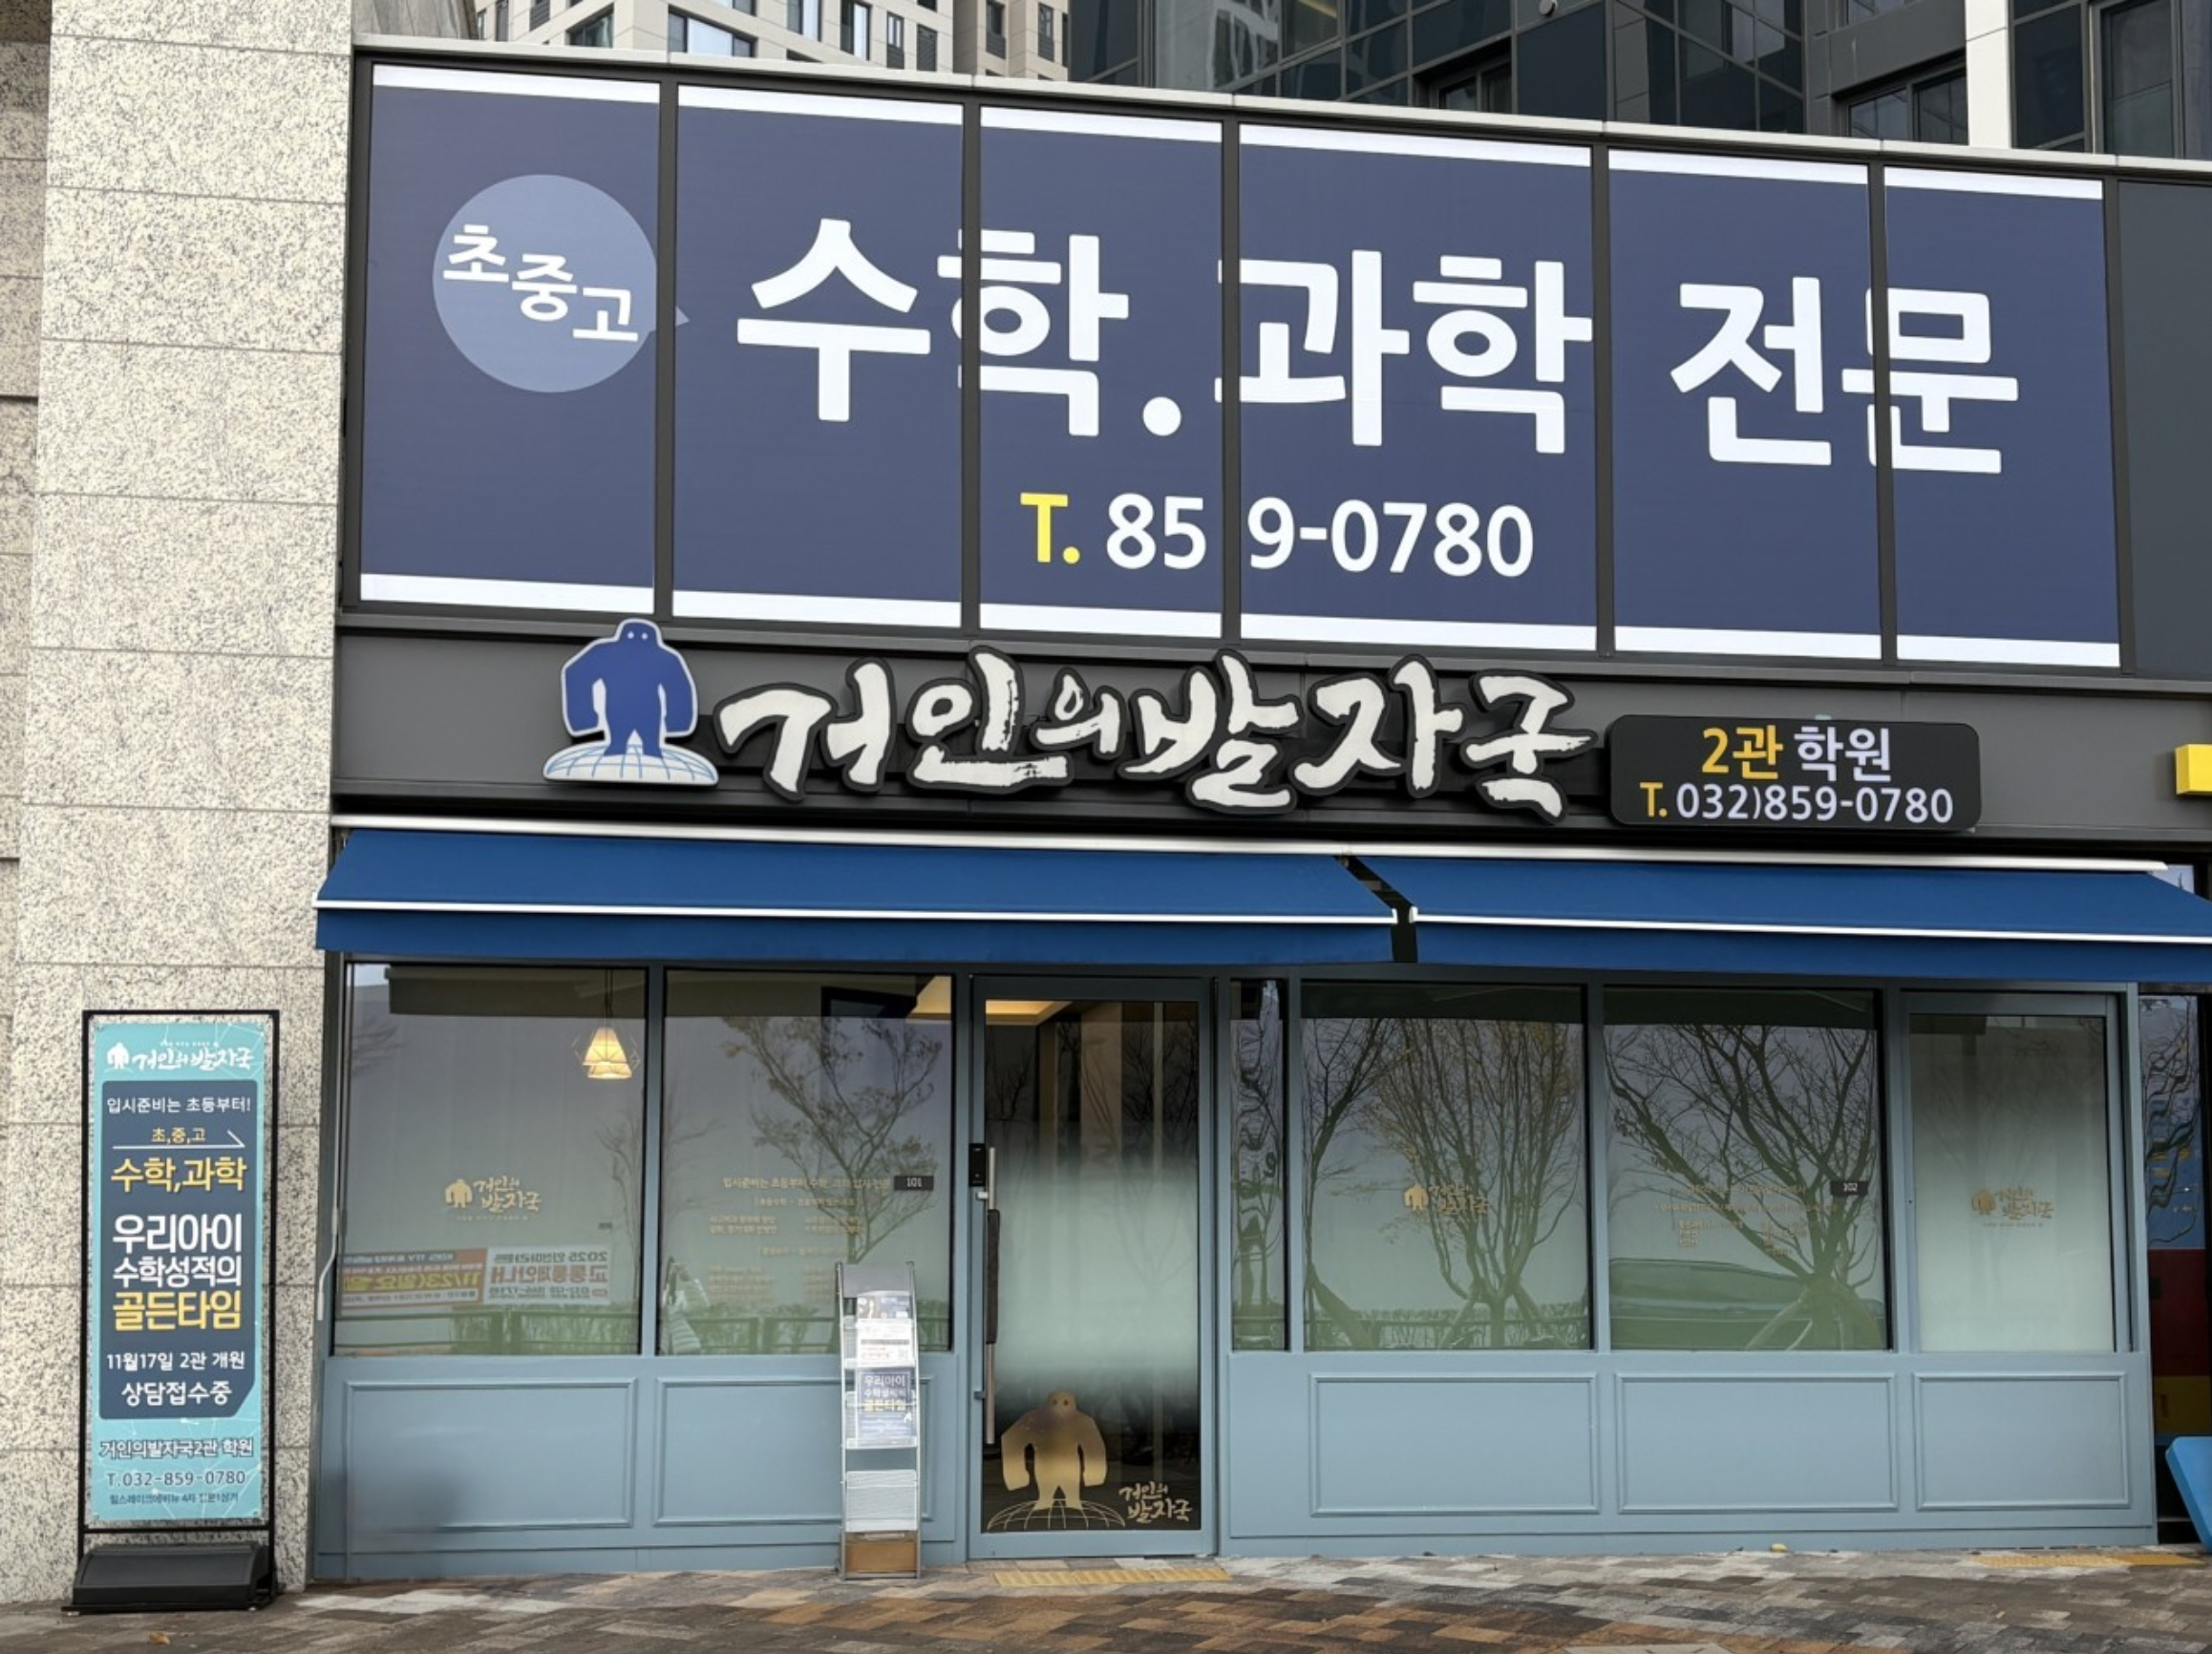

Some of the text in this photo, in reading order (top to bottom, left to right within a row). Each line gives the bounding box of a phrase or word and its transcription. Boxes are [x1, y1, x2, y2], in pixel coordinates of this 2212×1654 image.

[442, 223, 639, 342] 초중고
[1669, 275, 2019, 475] 전문
[1019, 491, 1081, 564] T.
[1701, 724, 1892, 783] 2관 학원
[1639, 781, 1954, 823] T. 032)859-0780
[106, 1096, 251, 1113] 입시준비는 초등부터!
[110, 1156, 247, 1193] 수학,과학
[906, 1177, 923, 1188] 101
[480, 1191, 542, 1213] 발자국
[112, 1213, 243, 1254] 우리아이
[112, 1255, 243, 1288] 수학성적의
[112, 1290, 242, 1331] 골든타임
[106, 1351, 246, 1371] 11월17일 2관 개원
[120, 1380, 233, 1408] 상담접수중
[222, 1436, 254, 1456] 학원
[1118, 1480, 1169, 1500] 거인의
[1127, 1497, 1193, 1524] 발자국
